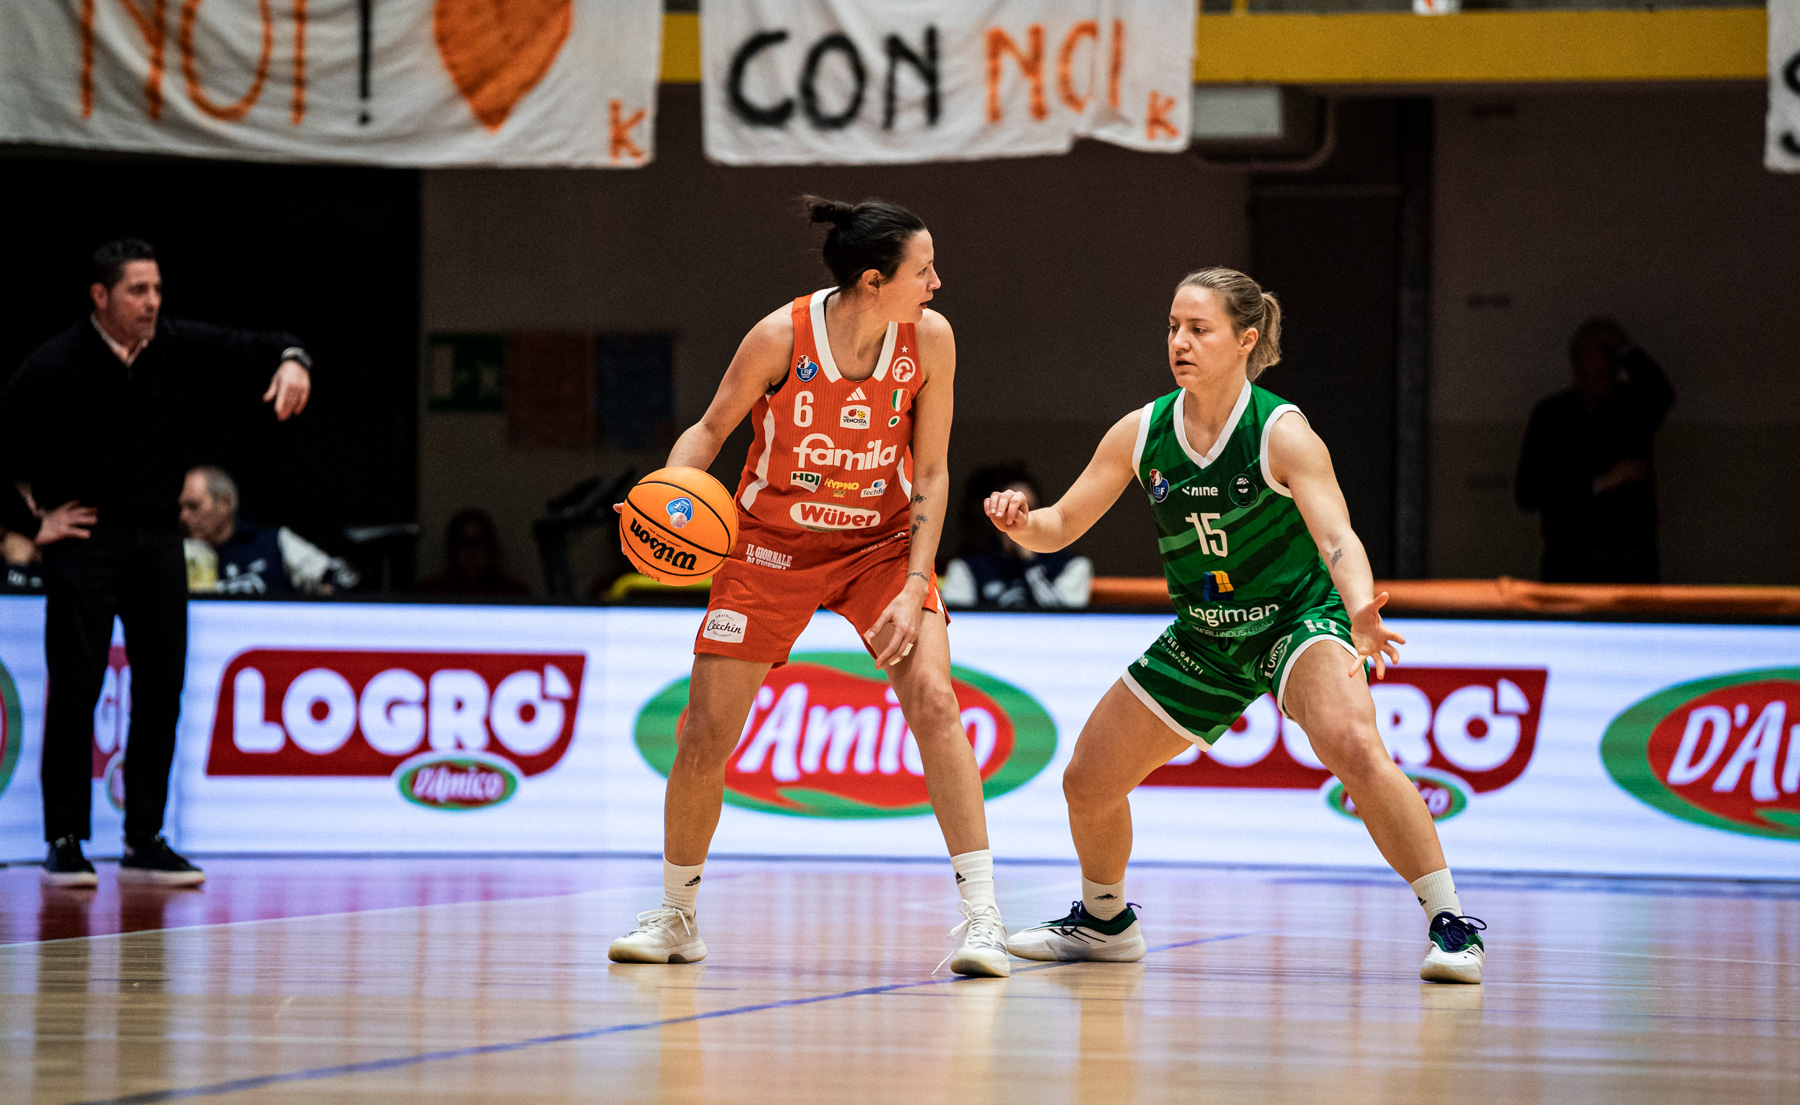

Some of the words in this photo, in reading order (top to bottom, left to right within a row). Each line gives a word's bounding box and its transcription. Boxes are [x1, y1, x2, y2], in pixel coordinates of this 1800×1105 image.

[725, 26, 939, 130] CON
[793, 391, 814, 428] 6
[792, 433, 897, 471] famila
[792, 472, 820, 486] HDI
[824, 477, 860, 491] HYPNO
[800, 503, 876, 527] Wüber
[629, 518, 697, 570] Wilson
[1185, 512, 1229, 558] 15
[746, 543, 755, 556] IL
[755, 546, 792, 567] GIORNALE
[707, 618, 742, 635] Cecchin
[1180, 650, 1204, 675] GATTI
